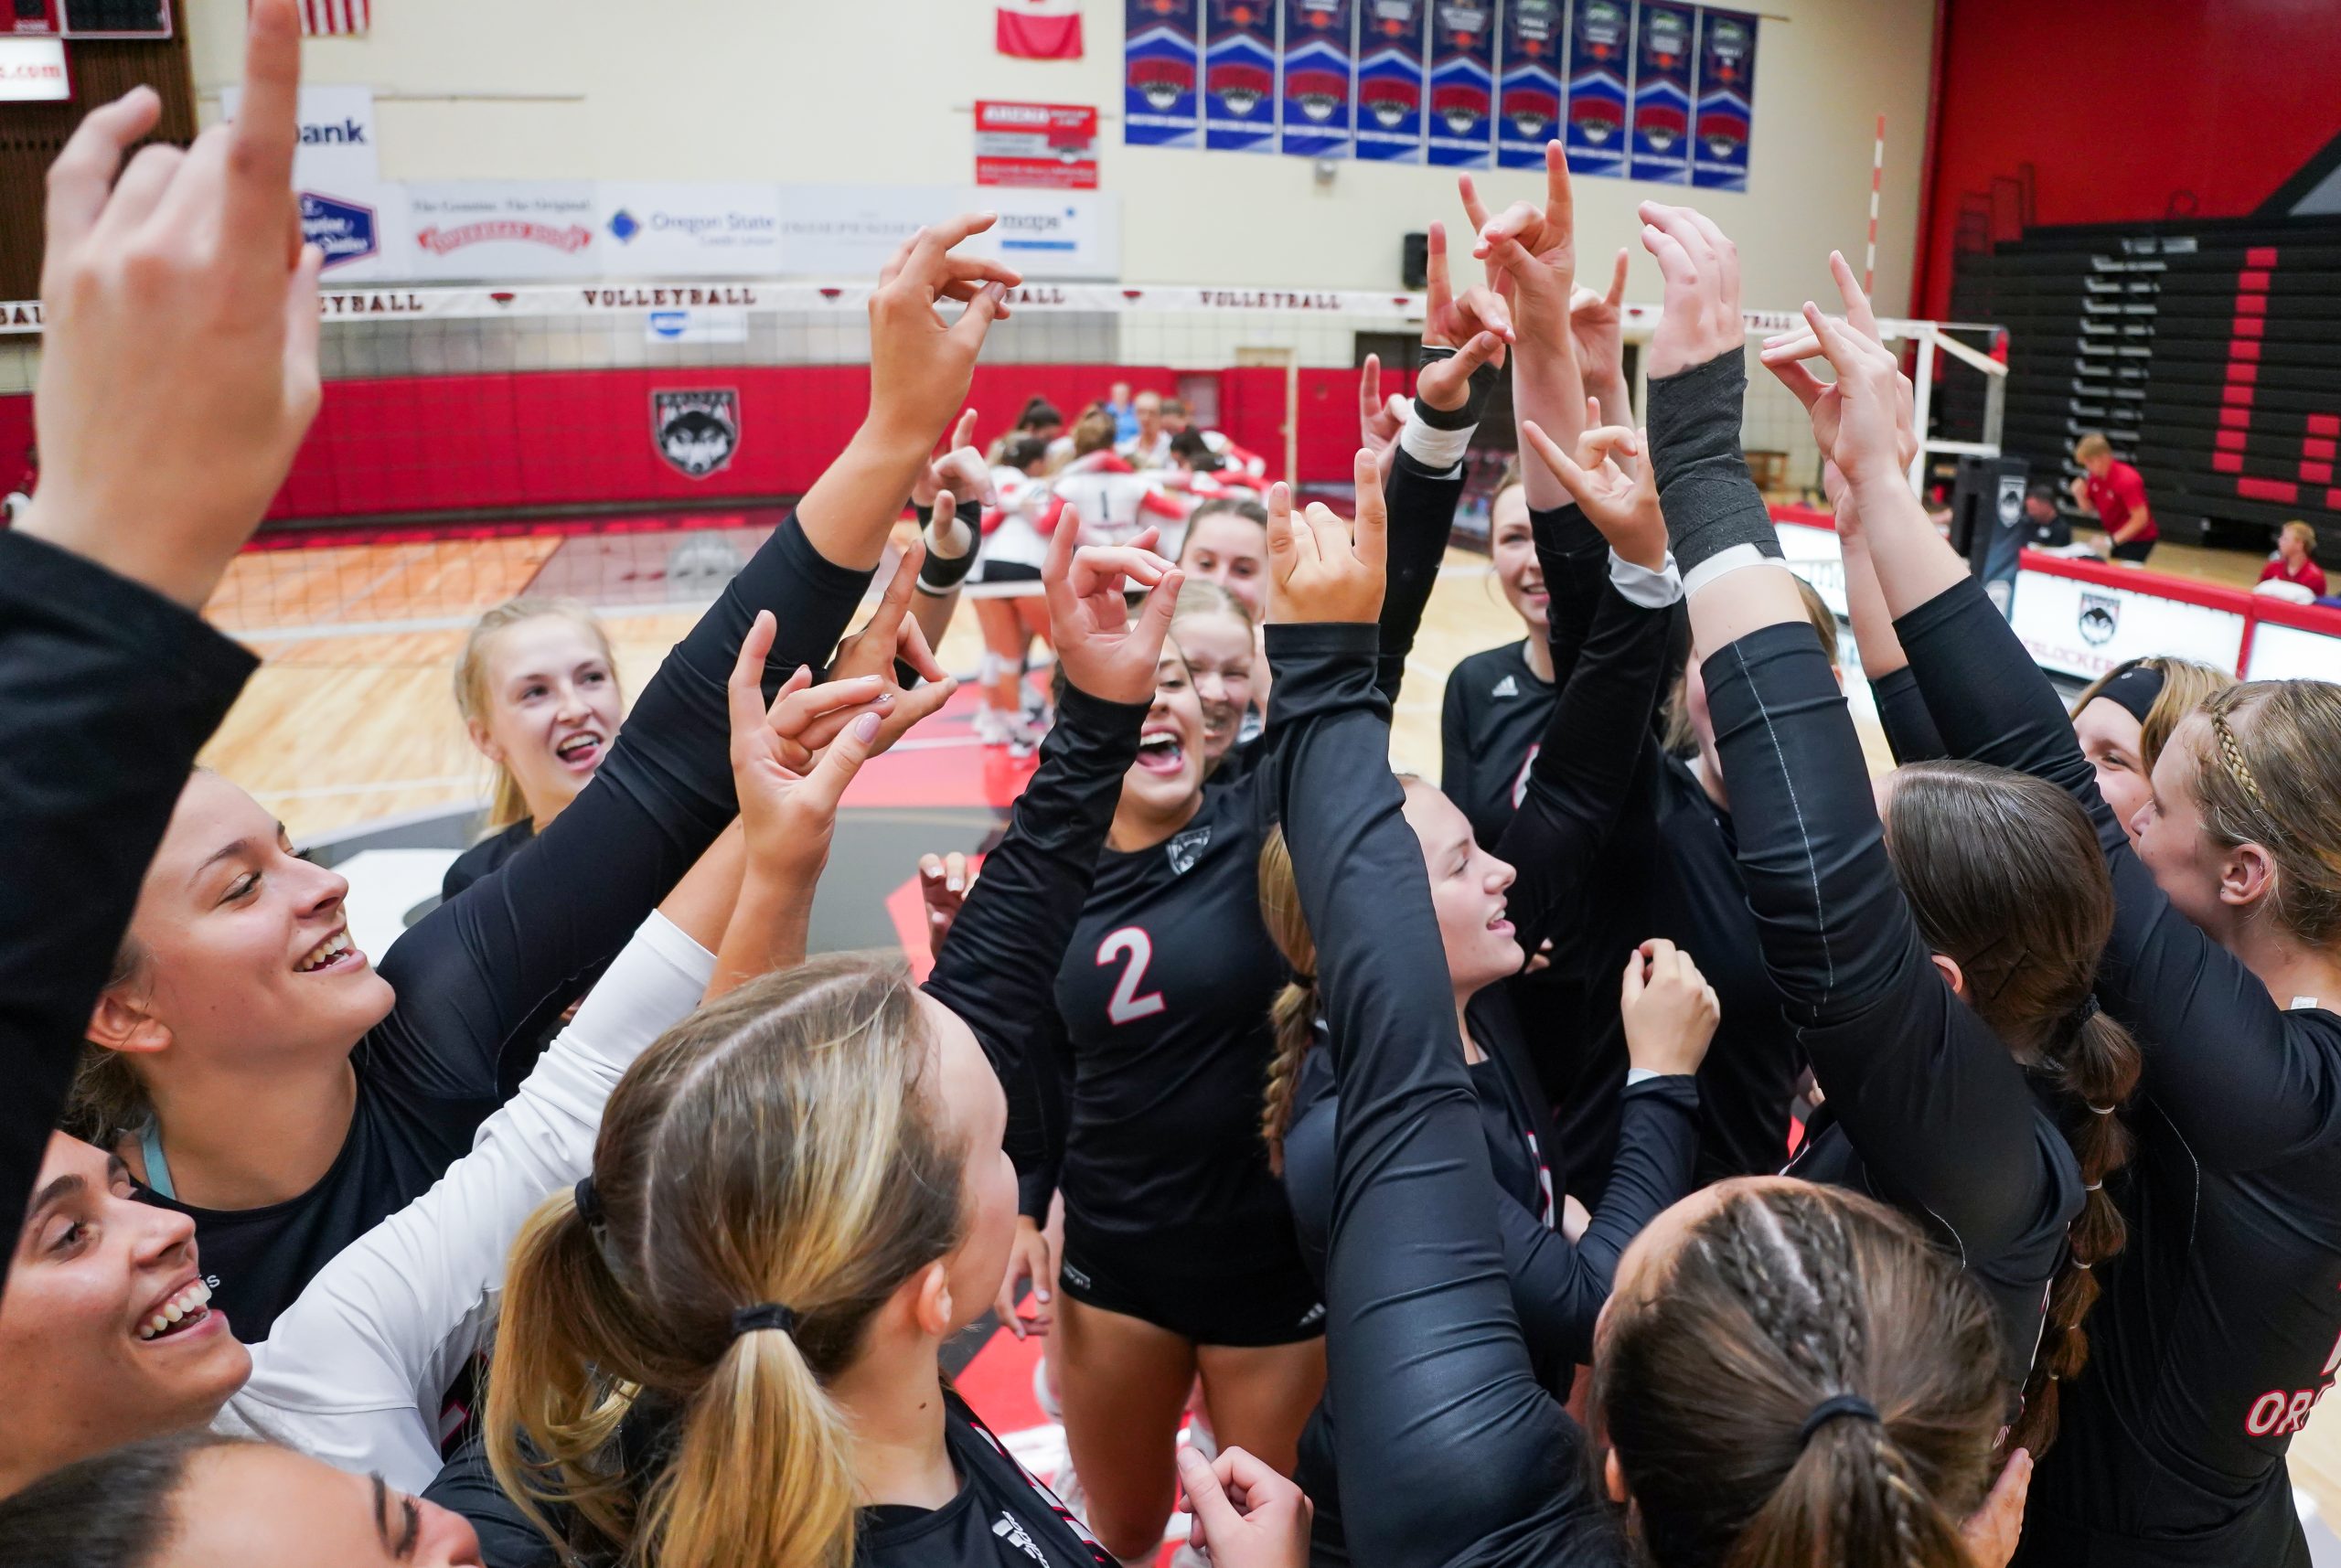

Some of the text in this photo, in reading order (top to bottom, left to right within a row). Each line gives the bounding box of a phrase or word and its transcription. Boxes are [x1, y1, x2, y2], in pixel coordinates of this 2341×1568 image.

[297, 116, 367, 144] ank
[651, 212, 775, 233] Oregon State
[583, 288, 756, 306] VOLLEYBALL
[1200, 291, 1342, 310] VOLLEYBALL
[1096, 925, 1167, 1026] 2
